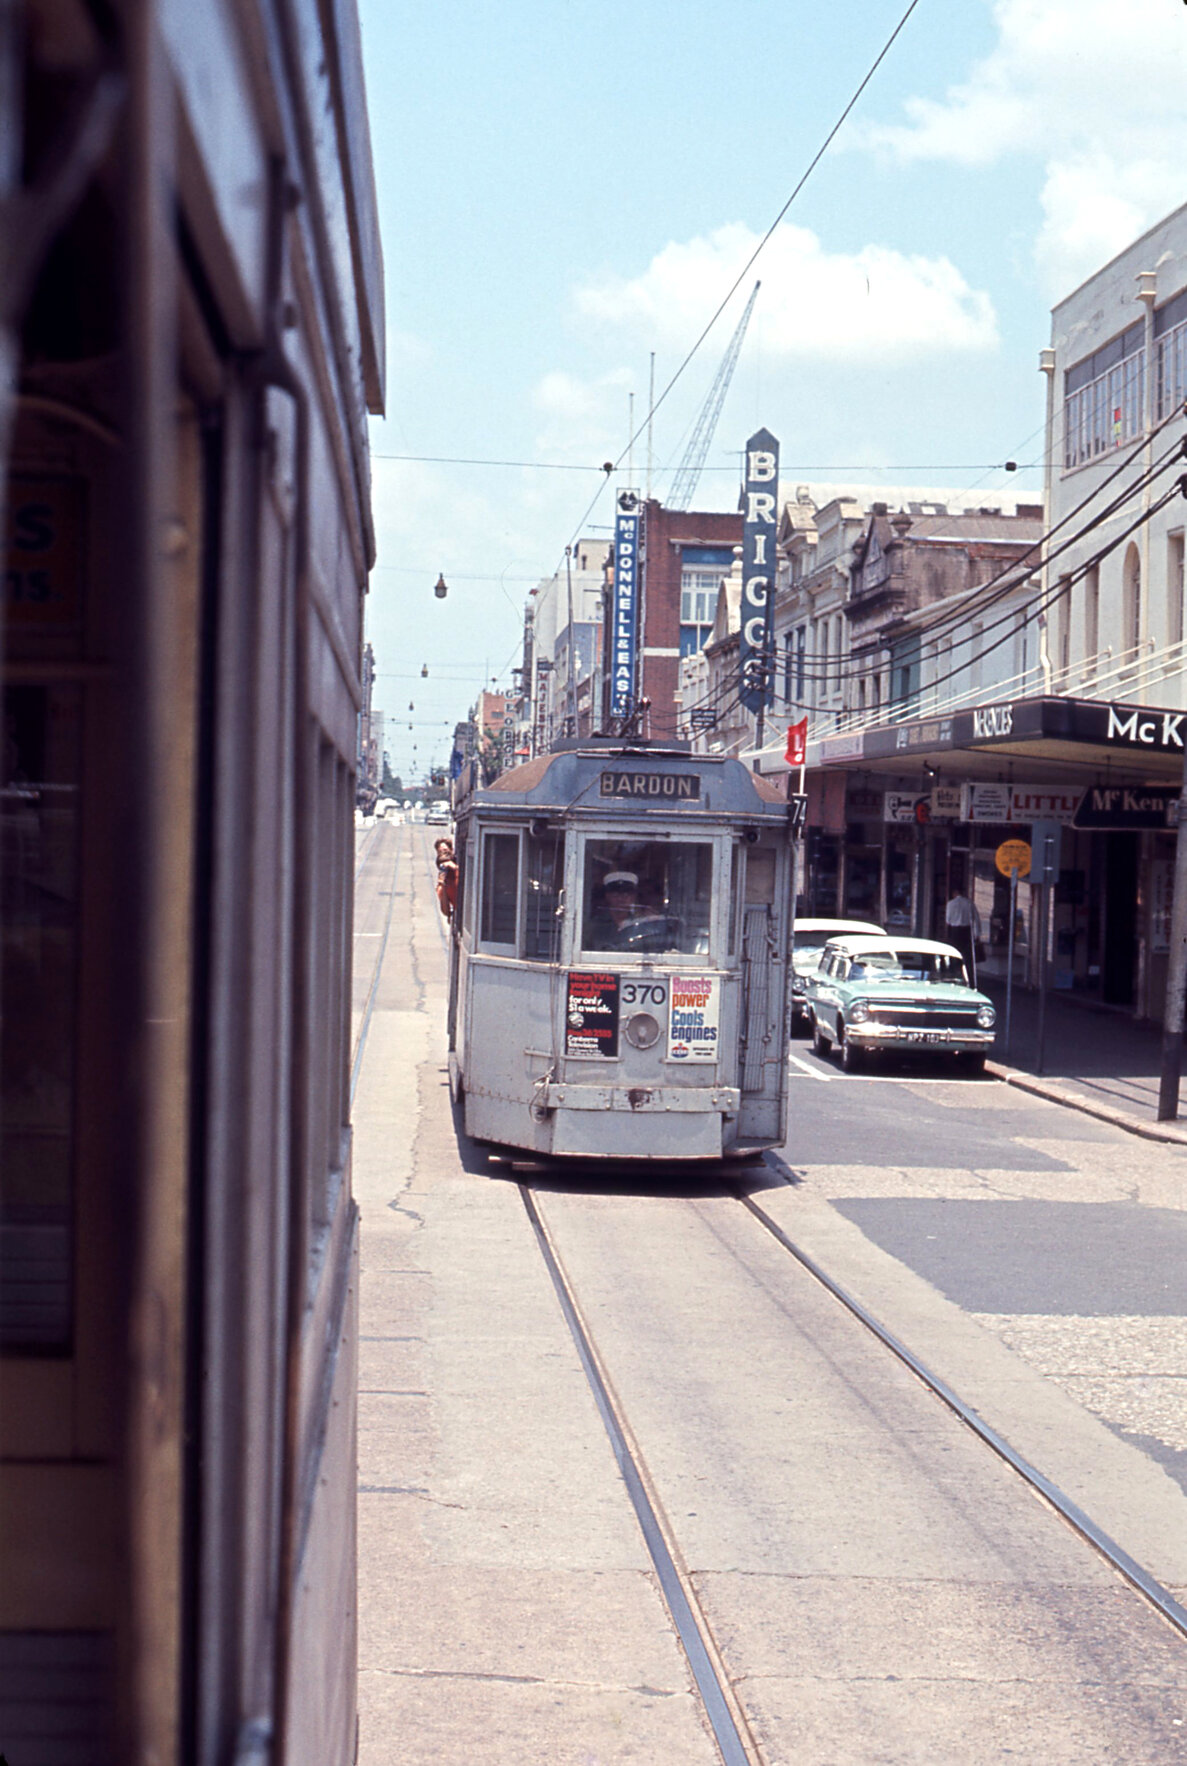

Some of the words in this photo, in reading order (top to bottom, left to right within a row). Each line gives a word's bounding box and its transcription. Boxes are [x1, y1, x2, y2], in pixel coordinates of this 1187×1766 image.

[619, 519, 636, 638] McDONNELL
[504, 690, 515, 768] GEORGE
[602, 774, 693, 796] BARDON
[672, 976, 712, 994] Boosts
[569, 995, 581, 1004] for
[582, 996, 603, 1006] only
[622, 984, 666, 1005] 370
[671, 994, 710, 1010] power
[671, 1010, 704, 1026] Cools
[671, 1026, 718, 1043] engines
